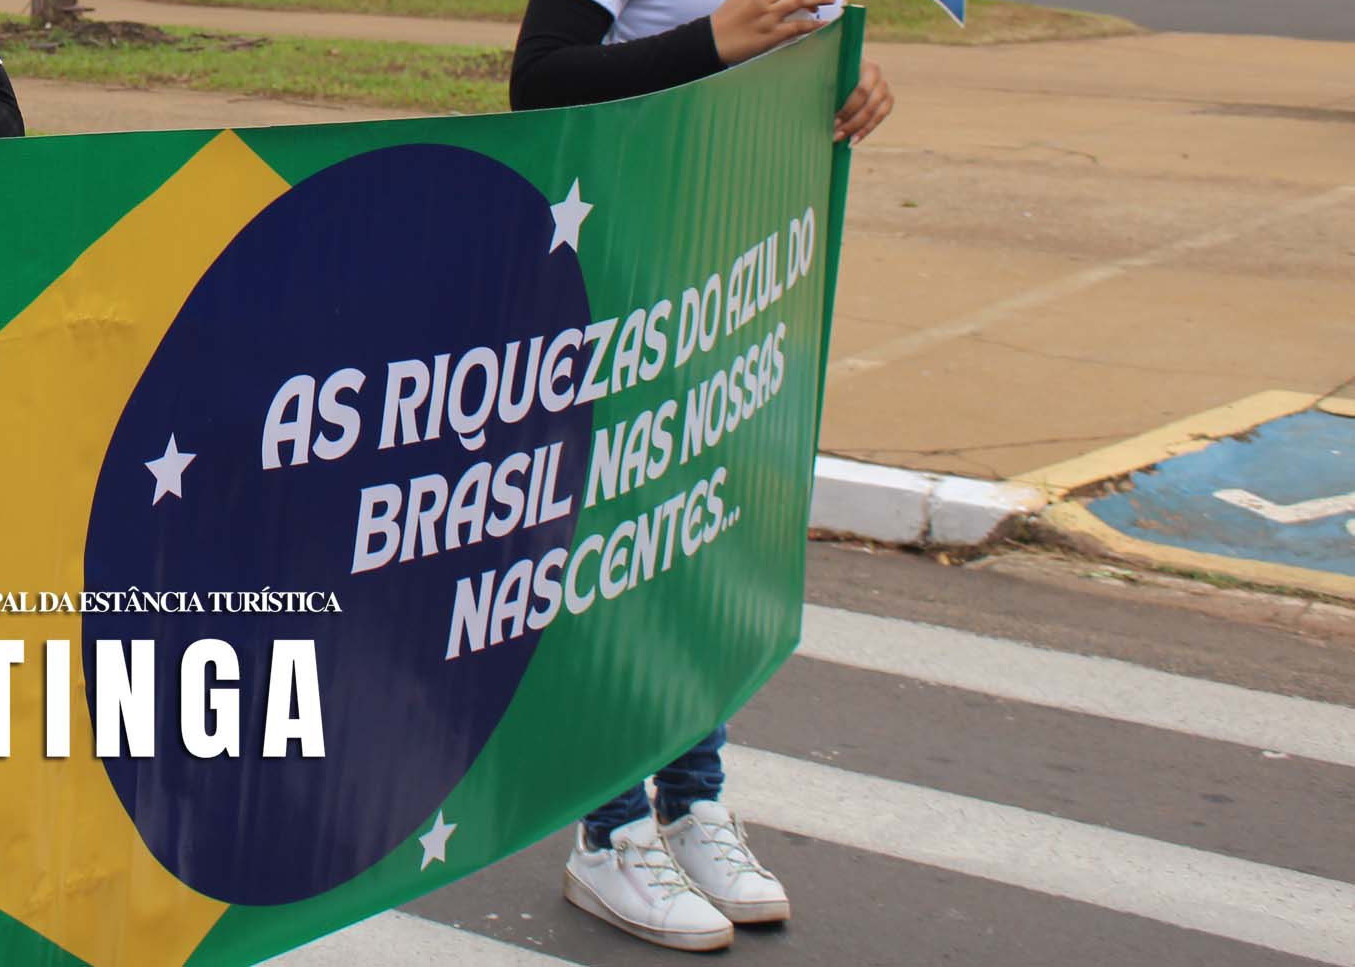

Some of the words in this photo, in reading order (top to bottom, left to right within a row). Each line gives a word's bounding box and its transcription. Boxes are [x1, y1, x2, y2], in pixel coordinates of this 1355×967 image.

[261, 368, 366, 470] AS
[378, 299, 672, 451] RIQUEZAS
[674, 274, 722, 370] DO
[724, 231, 783, 337] AZUL
[785, 206, 815, 292] DO
[350, 441, 572, 574] BRASIL
[583, 398, 678, 508] NAS
[679, 321, 786, 465] NOSSAS
